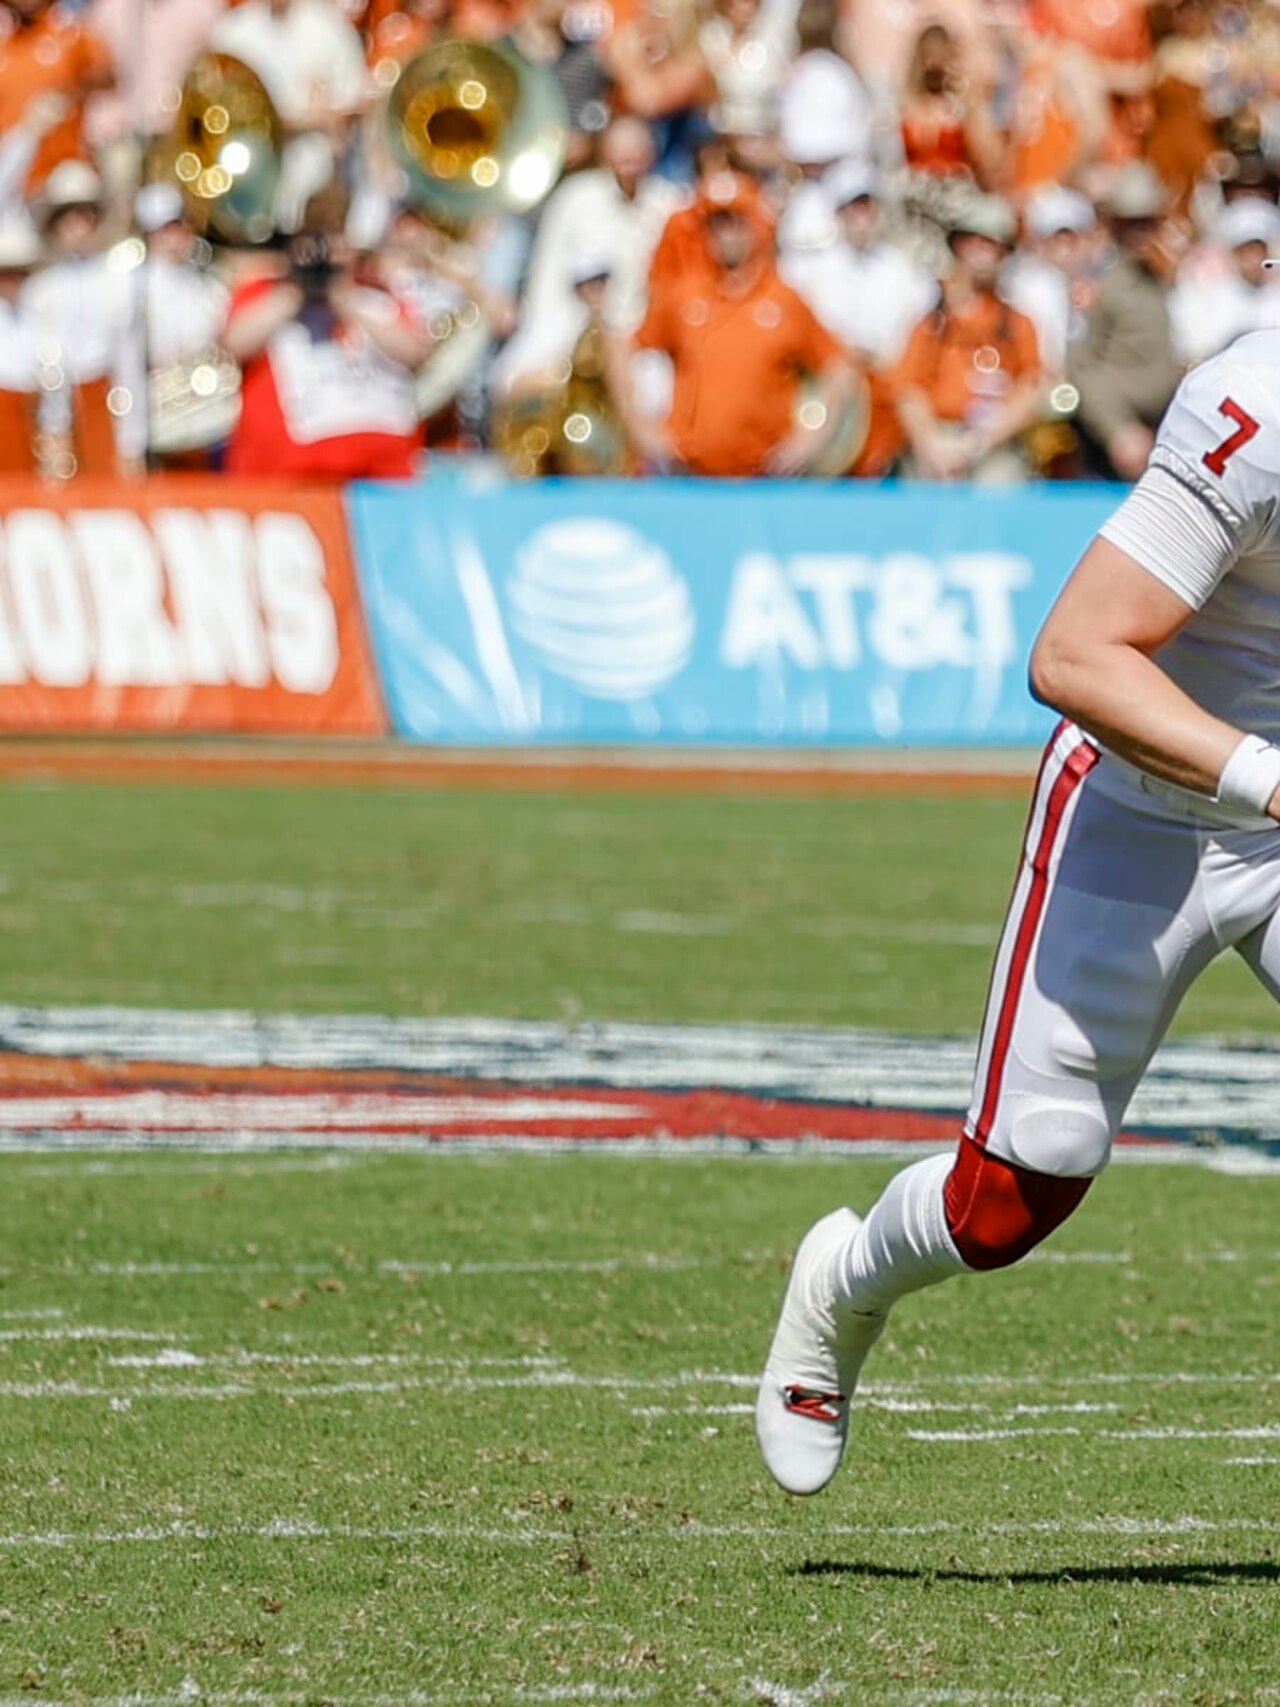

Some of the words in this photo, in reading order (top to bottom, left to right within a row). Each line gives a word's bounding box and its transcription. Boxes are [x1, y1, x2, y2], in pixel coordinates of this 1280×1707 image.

[1202, 397, 1260, 478] 7
[0, 507, 340, 694] ORNS
[719, 553, 1033, 670] AT&T
